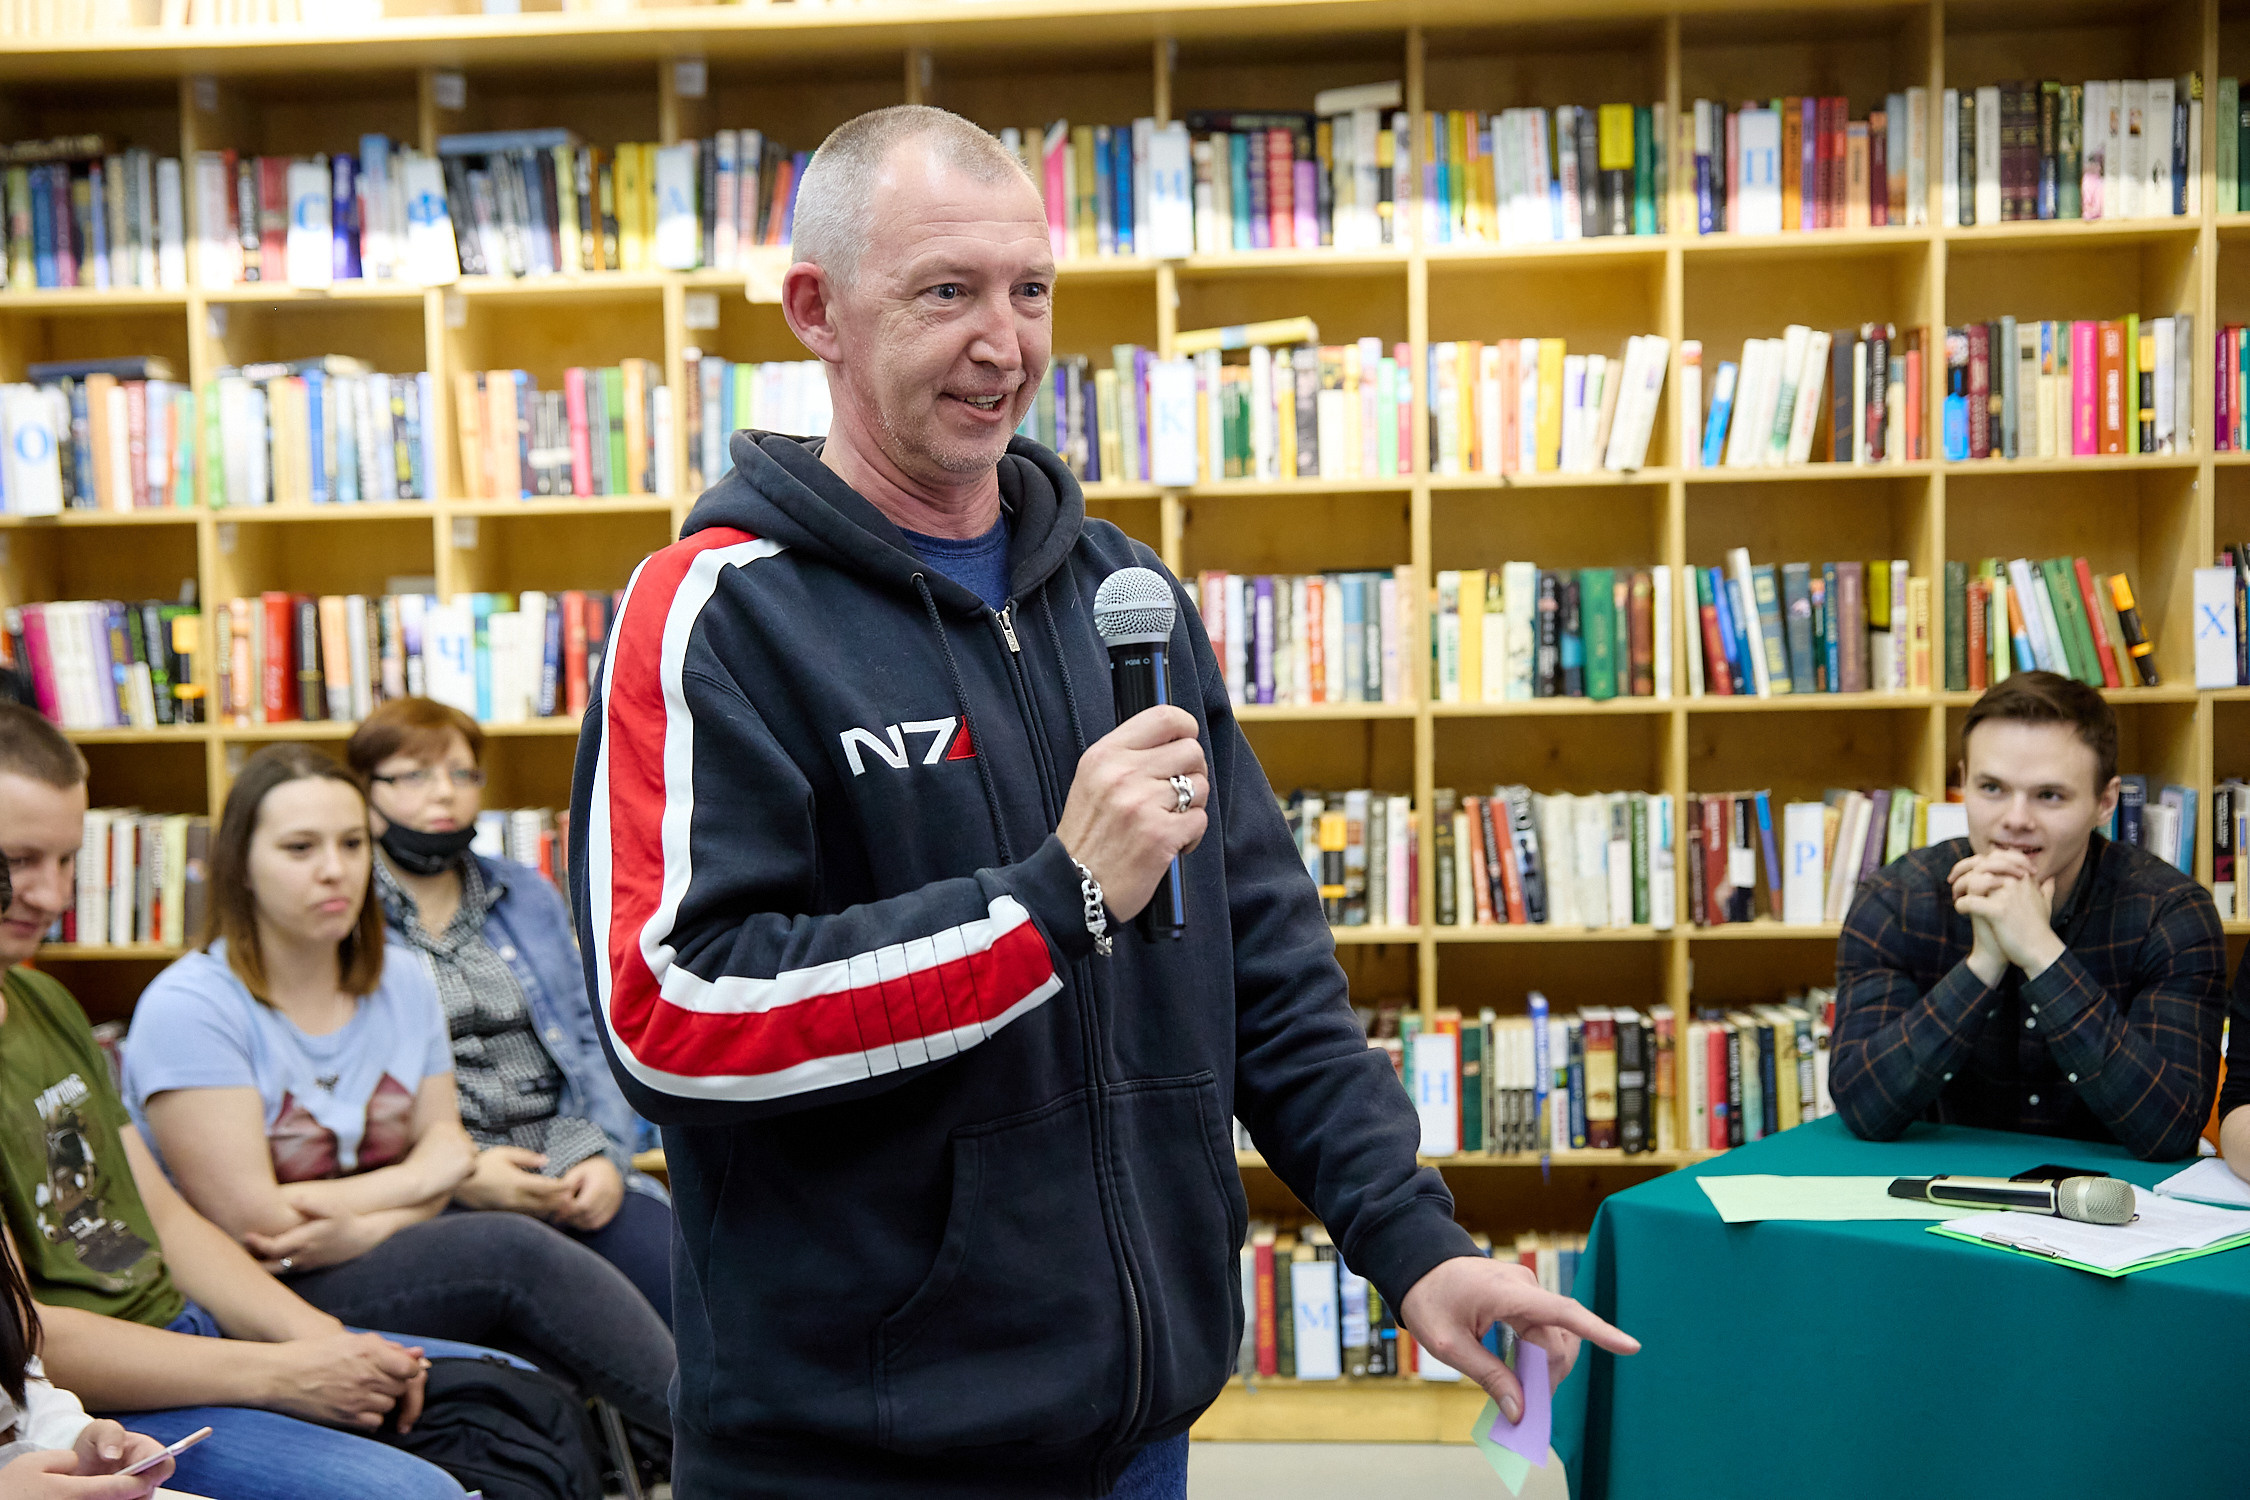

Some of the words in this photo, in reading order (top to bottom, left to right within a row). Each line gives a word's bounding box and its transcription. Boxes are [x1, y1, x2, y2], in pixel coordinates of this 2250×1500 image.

[1743, 147, 1775, 185] П
[1160, 399, 1187, 434] К
[13, 422, 55, 464] О
[2199, 602, 2227, 638] Х
[438, 635, 471, 674] Ч
[839, 715, 957, 777] N7
[1795, 840, 1817, 875] Р
[1421, 1069, 1449, 1106] Н
[1299, 1300, 1332, 1331] М
